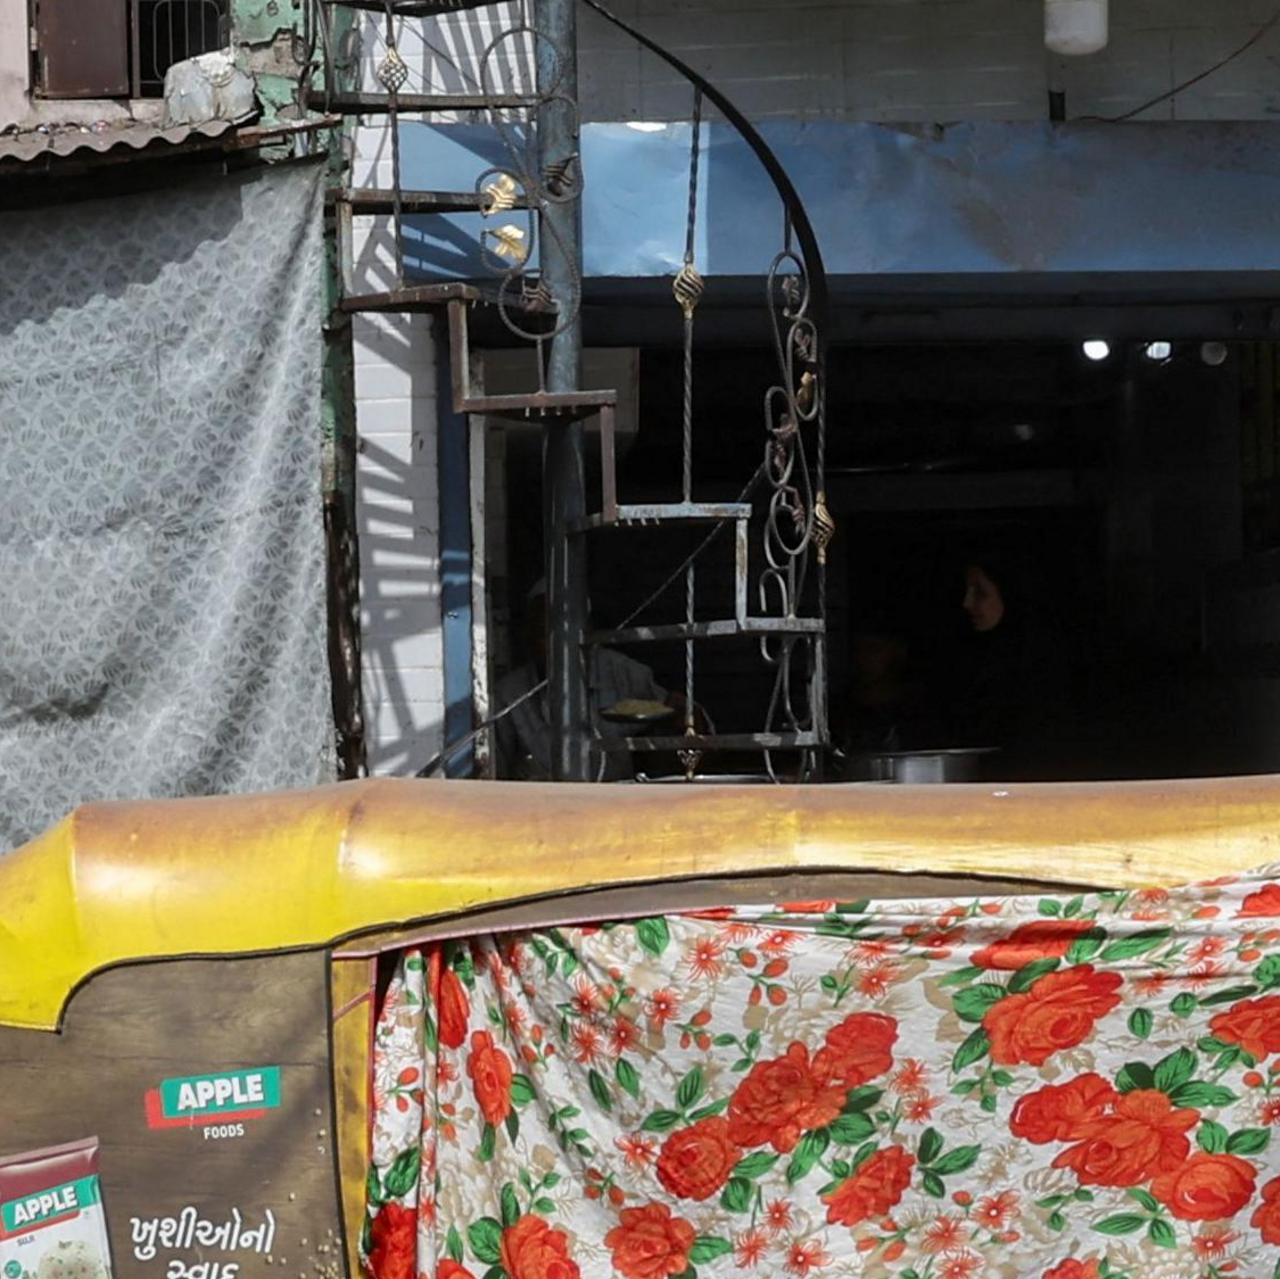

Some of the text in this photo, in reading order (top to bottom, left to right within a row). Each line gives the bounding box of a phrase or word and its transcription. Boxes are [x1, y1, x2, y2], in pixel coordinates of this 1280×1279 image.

[177, 1073, 265, 1111] APPLE
[203, 1123, 245, 1140] FOODS
[14, 1185, 78, 1226] APPLE
[130, 1206, 276, 1260] ખુશીઓનો
